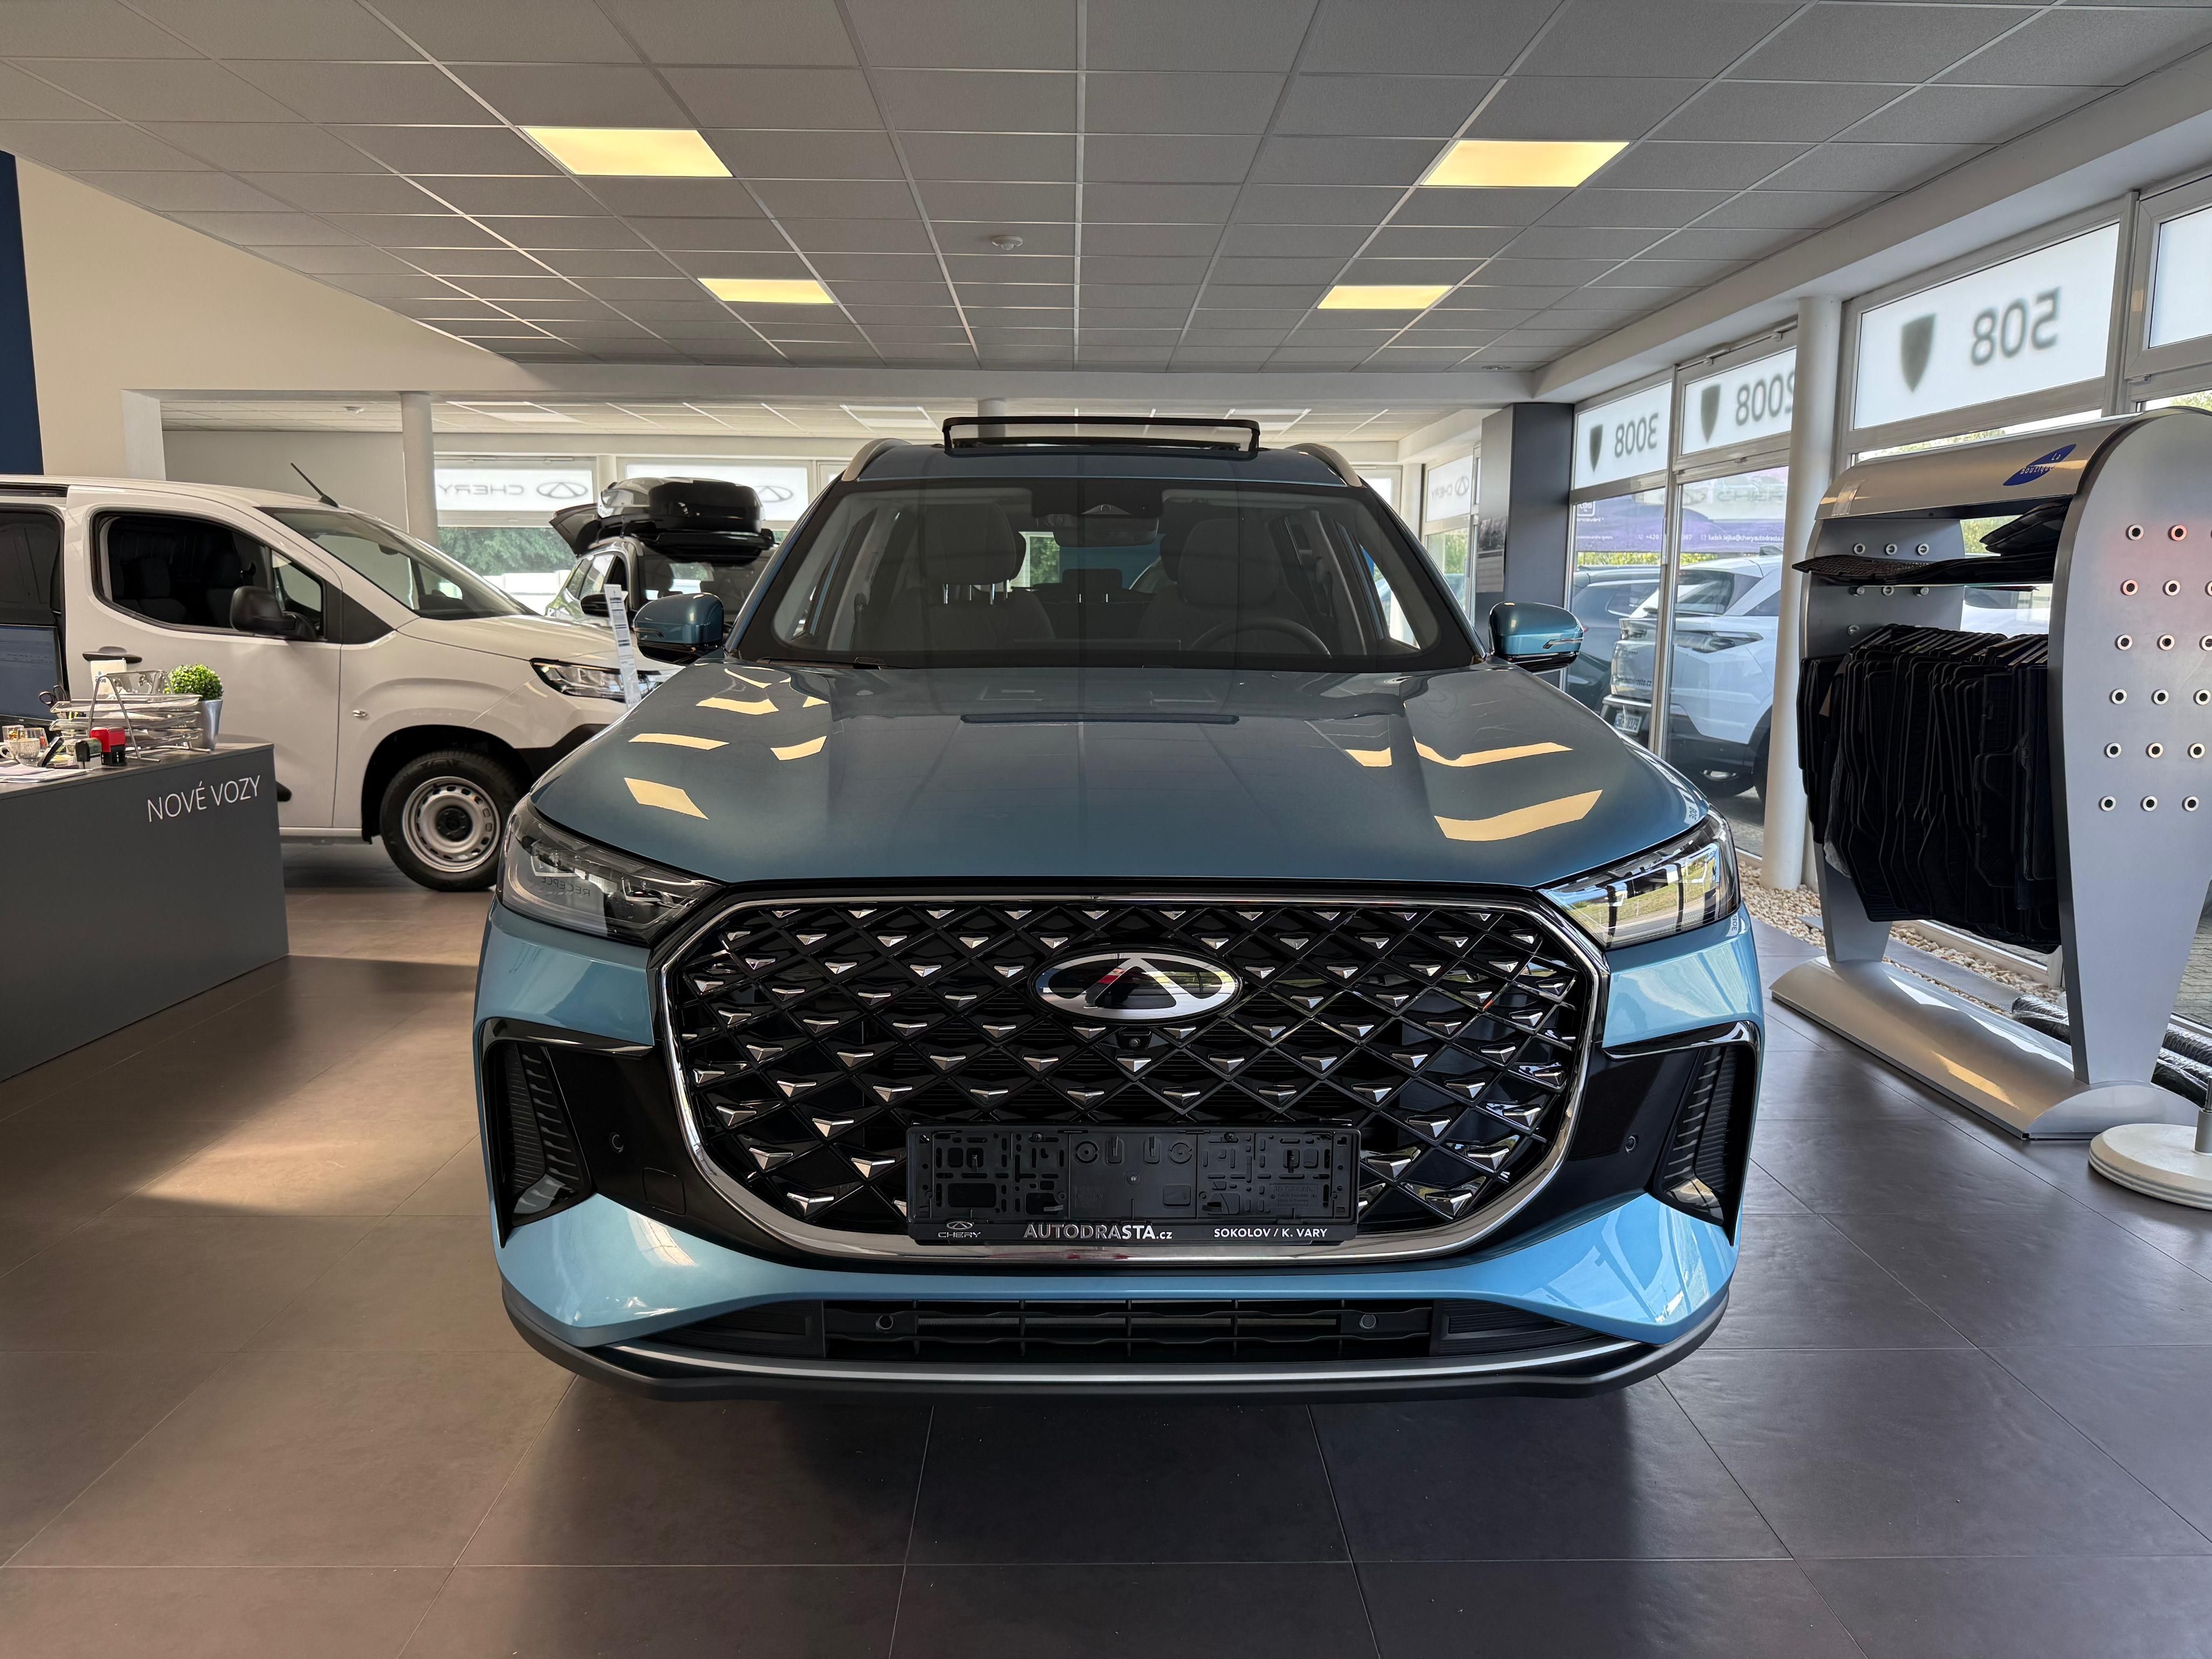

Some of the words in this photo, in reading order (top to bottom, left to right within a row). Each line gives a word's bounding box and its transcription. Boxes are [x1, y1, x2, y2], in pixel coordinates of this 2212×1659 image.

[1717, 489, 1784, 502] CHER
[1708, 534, 1784, 542] ludek.lejba@cheryautodrasta.c
[147, 780, 207, 822] NOVÉ
[211, 774, 260, 806] VOZY
[1023, 1224, 1172, 1239] AUTODRASTA.cz
[1214, 1228, 1271, 1237] SOKOLOV
[1273, 1228, 1279, 1237] /
[1282, 1228, 1293, 1237] K.
[1296, 1228, 1328, 1237] VARY
